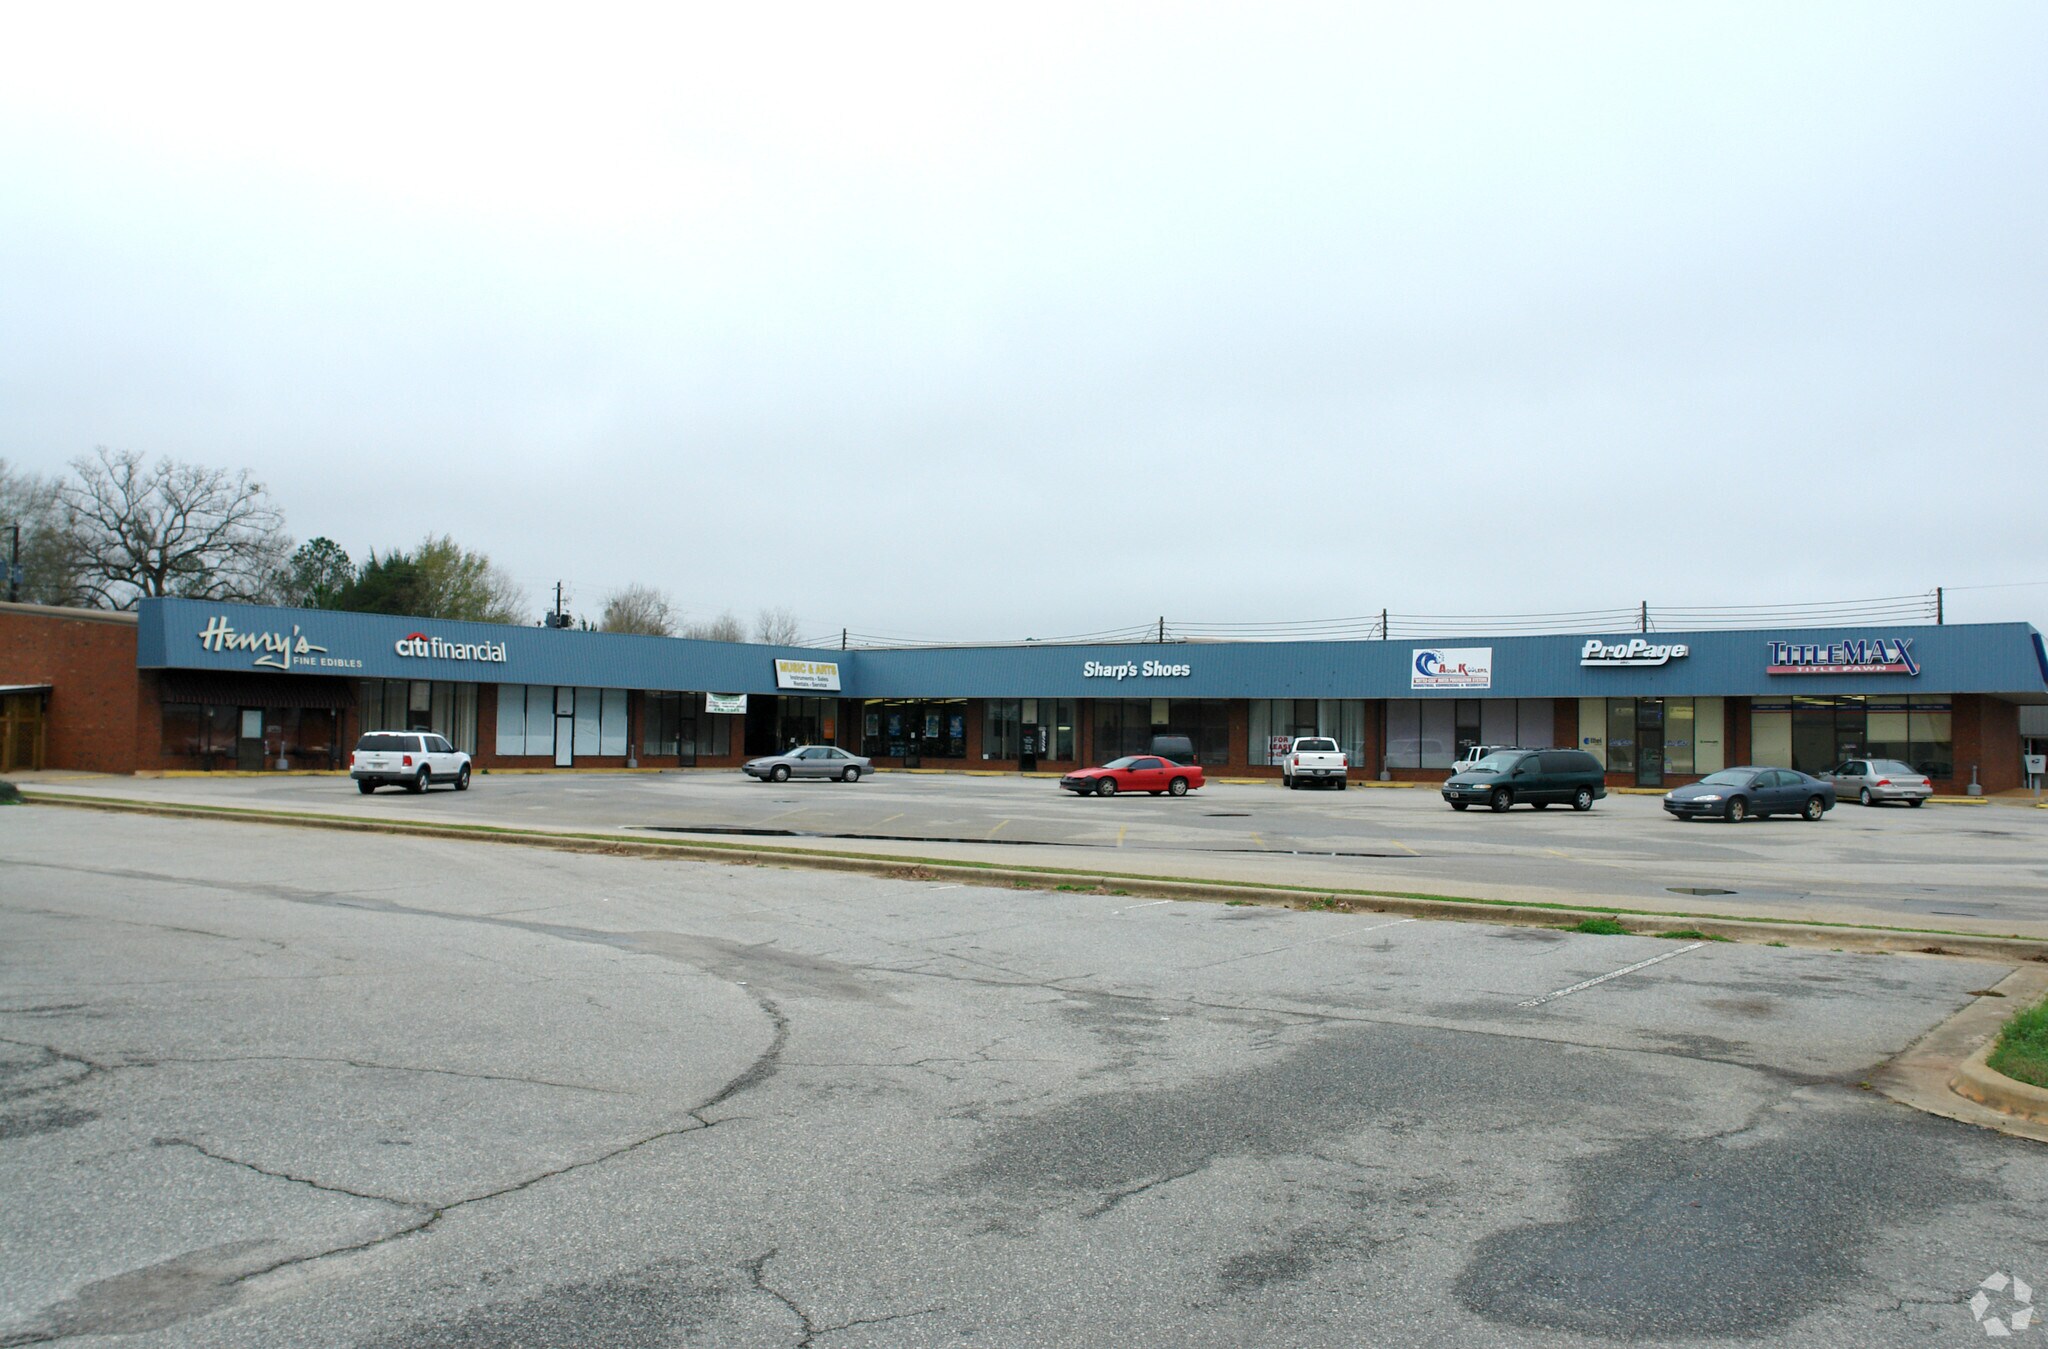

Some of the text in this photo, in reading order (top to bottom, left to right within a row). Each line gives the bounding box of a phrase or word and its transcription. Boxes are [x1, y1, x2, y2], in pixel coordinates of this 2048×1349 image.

[198, 615, 328, 669] Henry's
[1581, 638, 1687, 665] ProPage
[293, 656, 363, 668] FINE EDIBLES
[779, 660, 806, 673] MUSIC
[815, 663, 837, 676] ARTS
[1083, 660, 1191, 680] Sharp's Shoes
